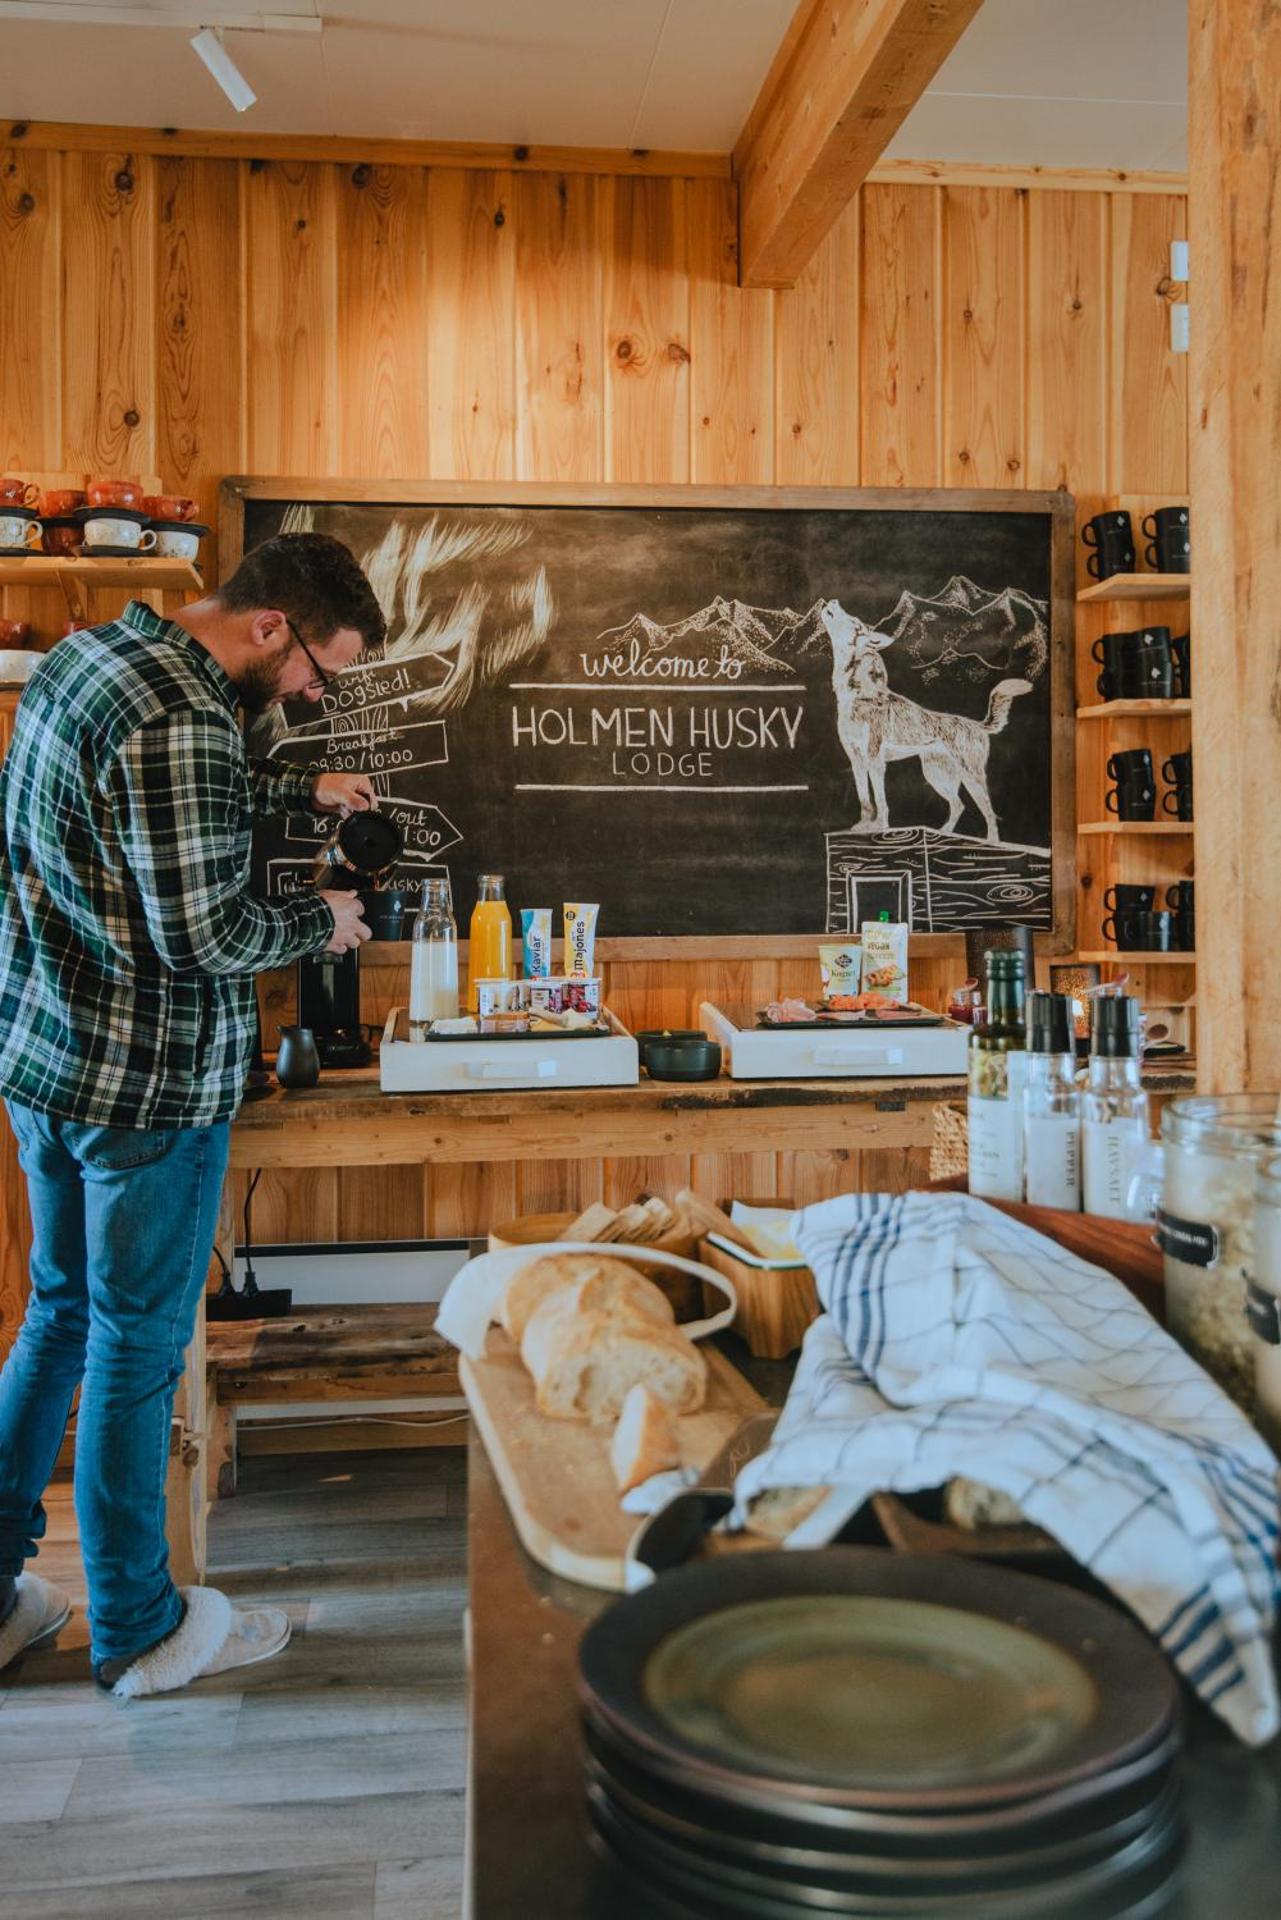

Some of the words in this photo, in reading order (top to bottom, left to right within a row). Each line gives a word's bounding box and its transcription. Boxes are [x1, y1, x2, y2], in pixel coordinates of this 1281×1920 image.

[580, 638, 711, 678] welcome
[712, 644, 747, 680] to
[512, 705, 674, 748] HOLMEN
[689, 705, 804, 749] HUSKY
[612, 751, 715, 777] LODGE
[532, 936, 541, 973] Kaviar
[574, 920, 586, 971] majones
[1065, 1131, 1076, 1187] PEPPER
